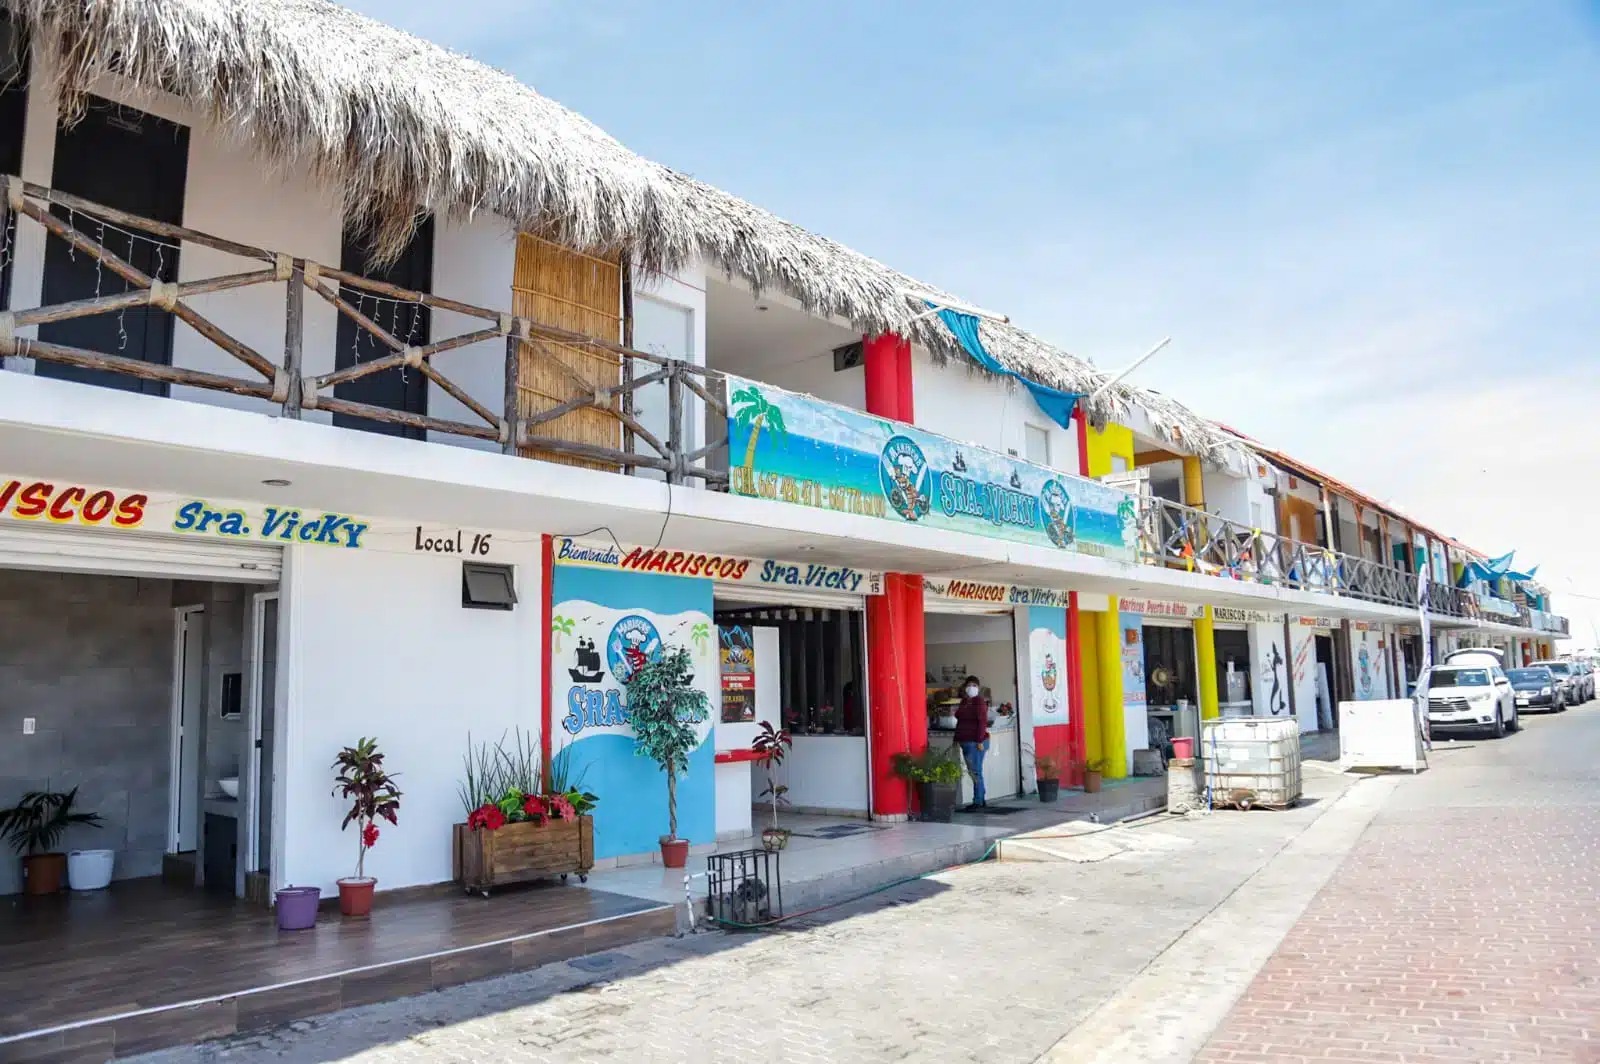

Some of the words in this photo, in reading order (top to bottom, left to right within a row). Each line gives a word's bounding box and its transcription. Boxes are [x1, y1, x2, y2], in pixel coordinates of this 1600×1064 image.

[173, 501, 250, 538] Sra.
[415, 526, 463, 553] Local
[470, 532, 491, 556] 16
[621, 546, 751, 580] MARISCOS
[760, 559, 802, 586] Sra.
[870, 582, 879, 593] 15
[947, 580, 1005, 602] MARISCOS
[1214, 607, 1246, 621] MARISCOS
